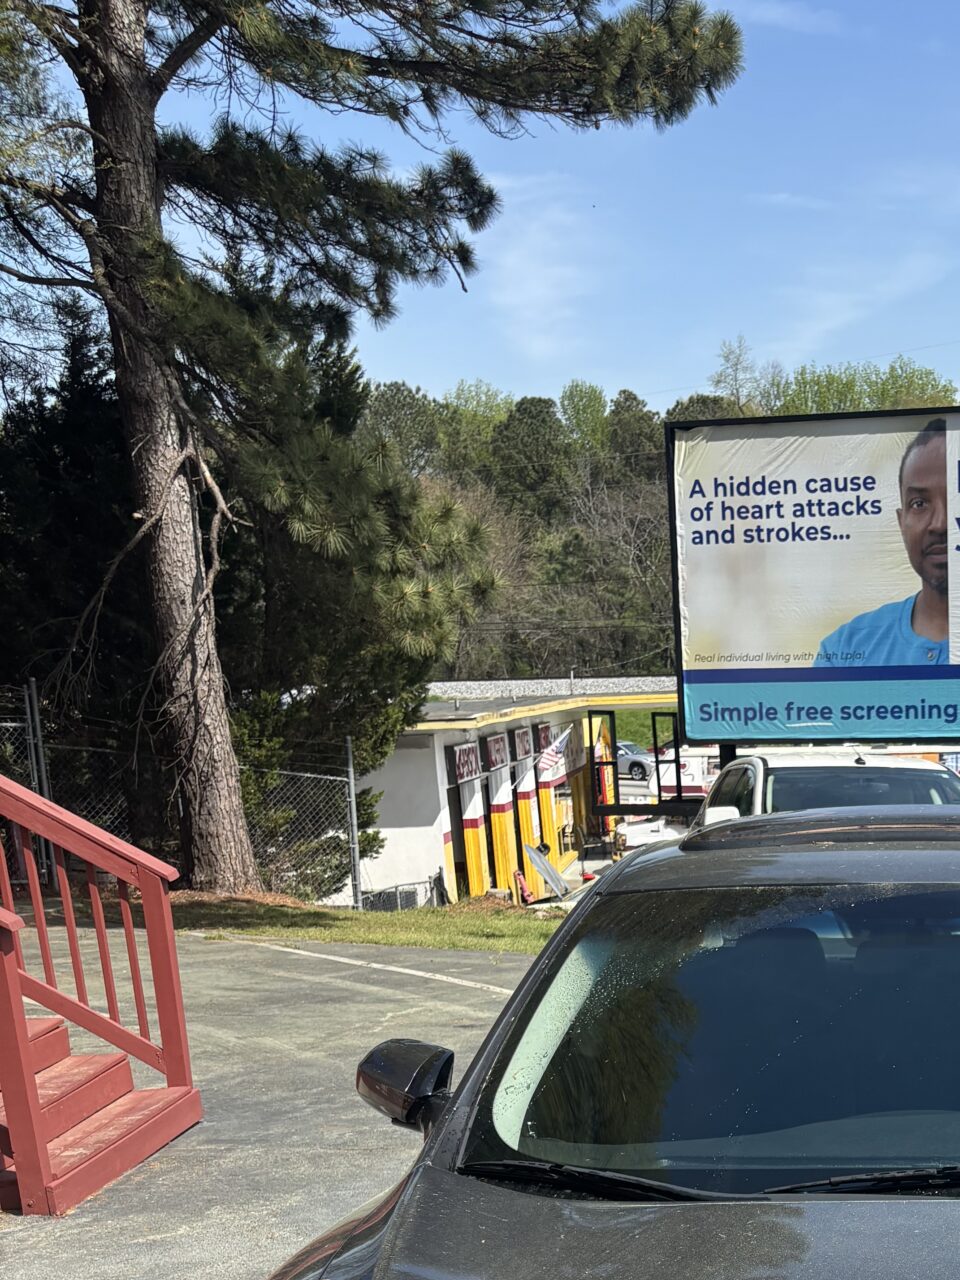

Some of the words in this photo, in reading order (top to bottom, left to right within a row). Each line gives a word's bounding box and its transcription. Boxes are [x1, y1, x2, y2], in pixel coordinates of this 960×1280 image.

[689, 479, 706, 499] A
[713, 475, 798, 498] hidden
[805, 475, 877, 495] cause
[690, 501, 714, 522] of
[721, 499, 785, 521] heart
[792, 494, 882, 519] attacks
[691, 524, 735, 545] and
[743, 521, 851, 544] strokes...
[694, 653, 715, 663] Real
[717, 652, 763, 663] individual
[765, 651, 790, 664] living
[793, 650, 814, 662] with
[816, 650, 838, 664] high
[699, 701, 778, 727] Simple
[784, 701, 834, 722] free
[840, 698, 959, 724] screening
